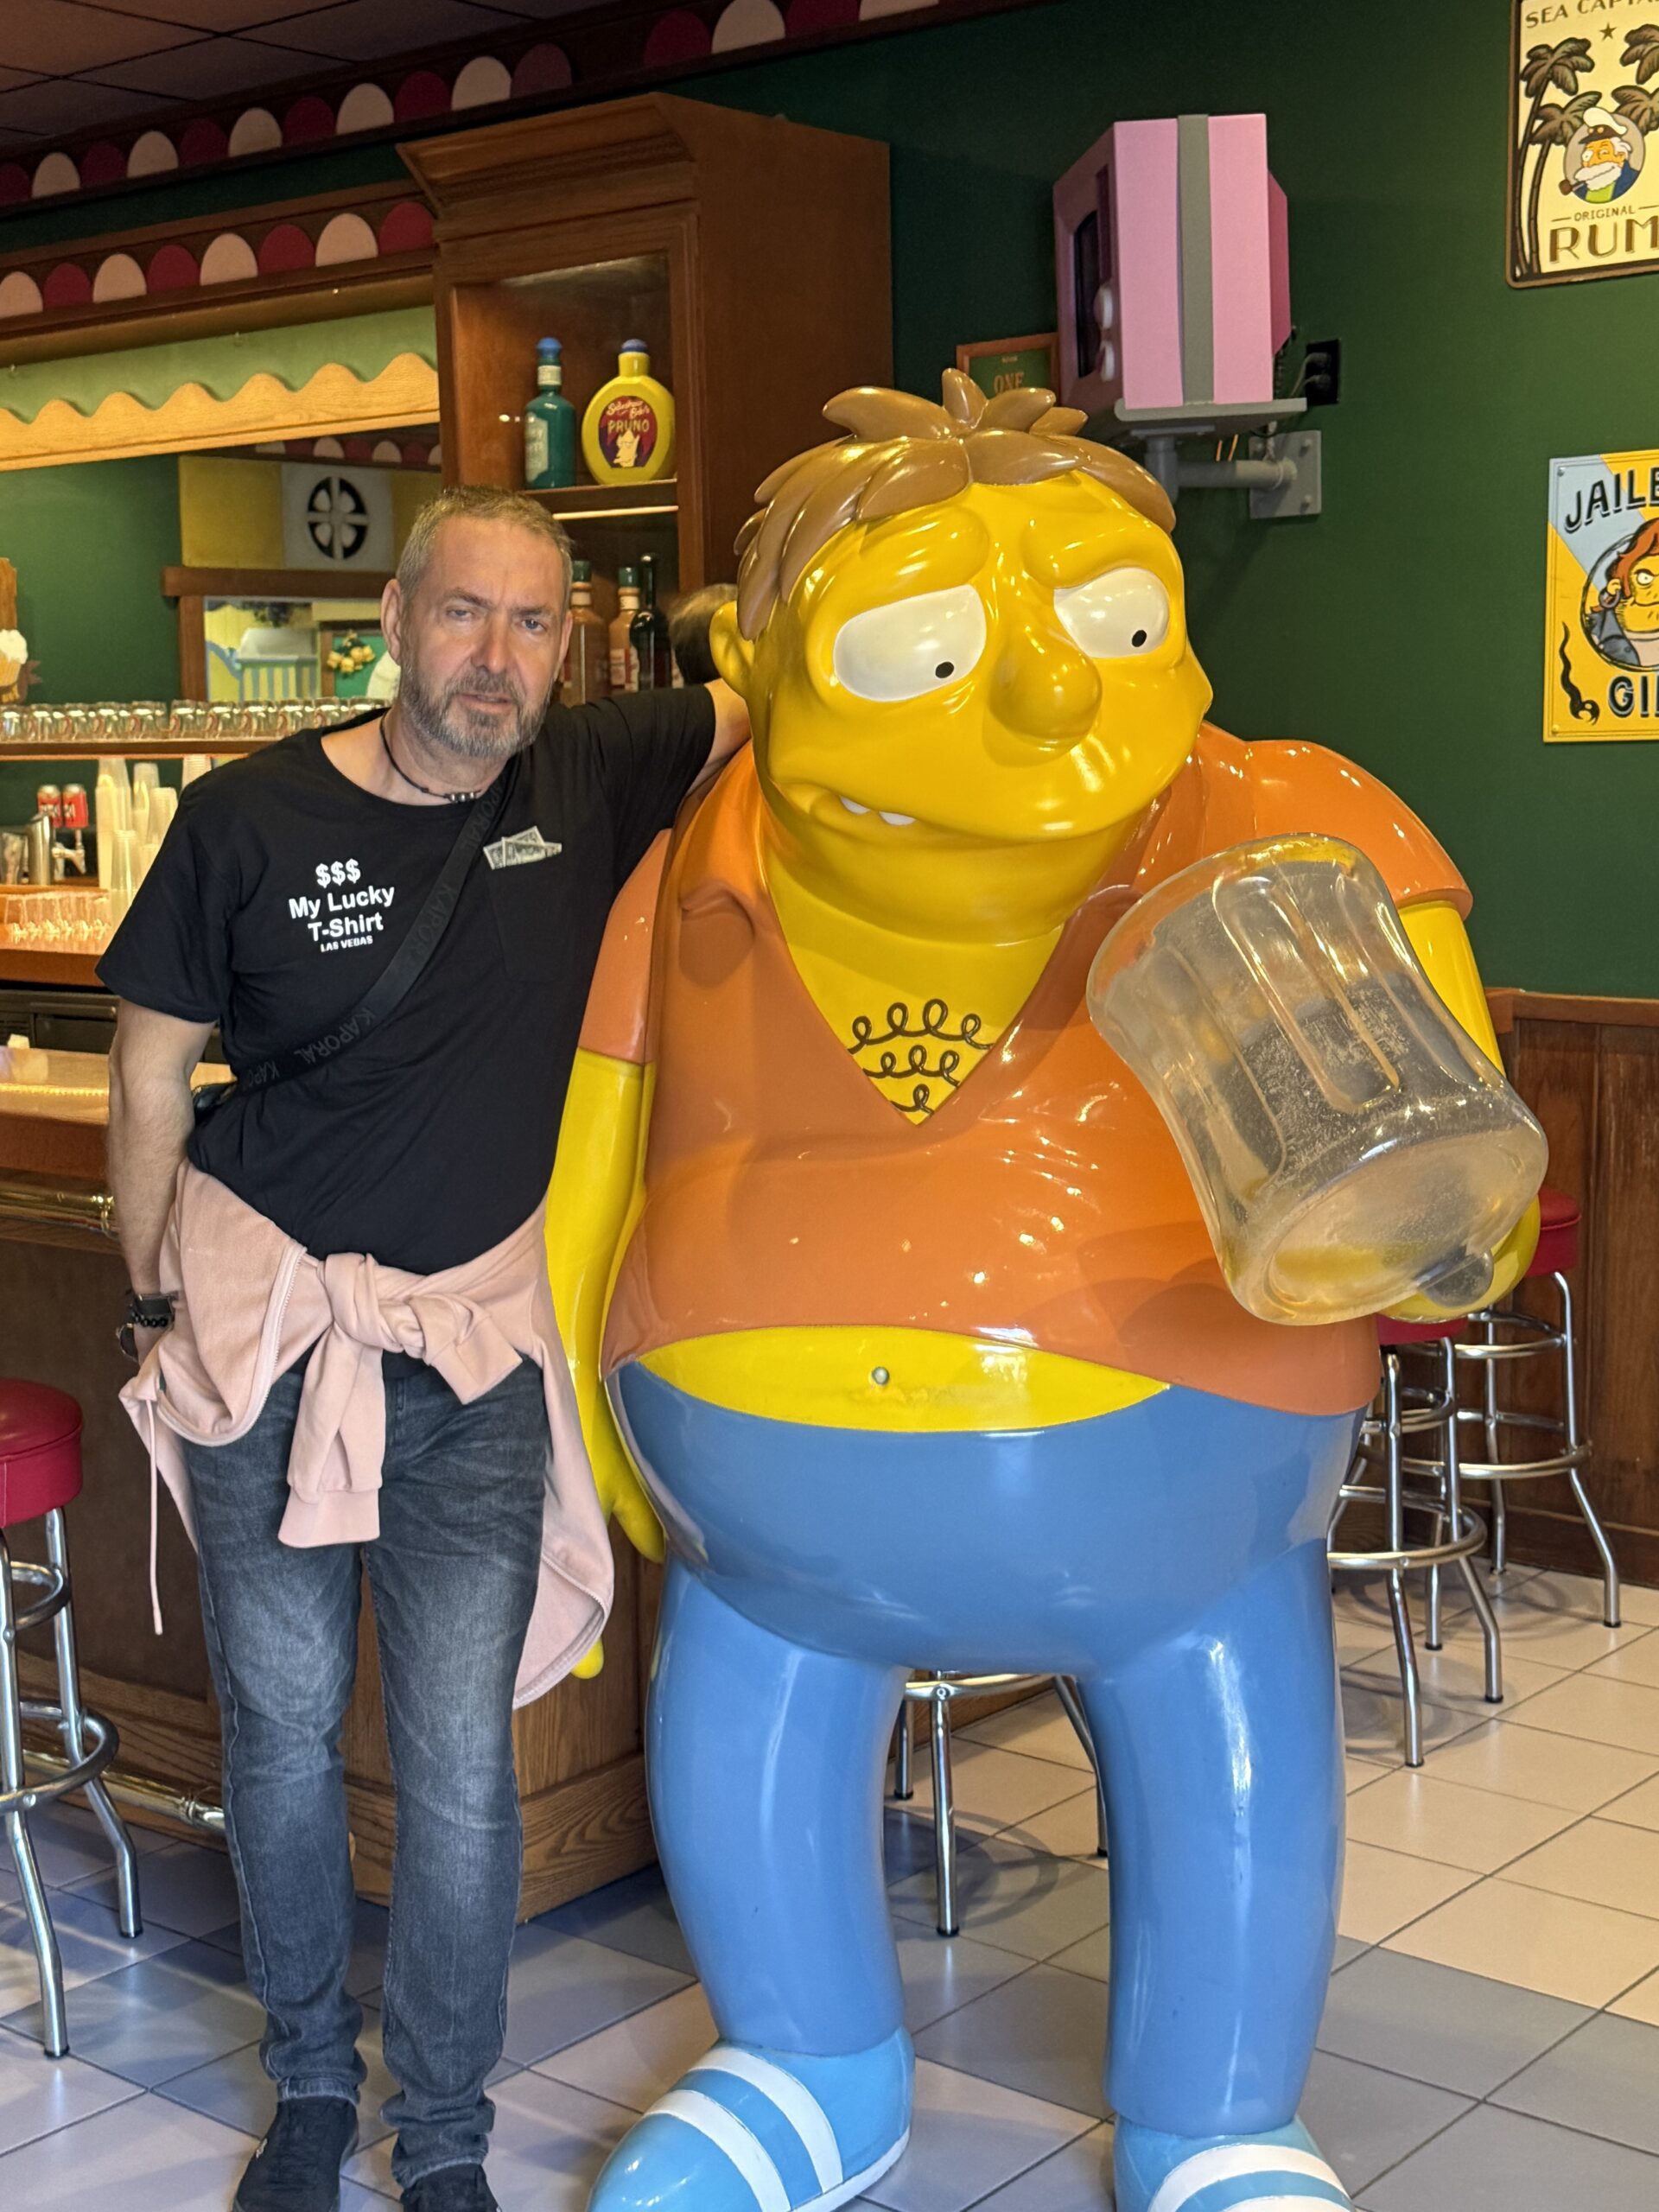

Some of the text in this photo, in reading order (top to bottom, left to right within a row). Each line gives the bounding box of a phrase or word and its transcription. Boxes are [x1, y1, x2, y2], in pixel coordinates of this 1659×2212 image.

[1526, 0, 1659, 29] SEA CAP
[1573, 205, 1636, 222] ORIGINAL
[1548, 215, 1659, 264] RUM
[607, 419, 650, 434] PRUNO
[315, 858, 361, 888] $$$
[289, 886, 395, 919] My Lucky
[308, 912, 385, 942] T-Shirt
[321, 935, 373, 953] LAS VEGAS
[293, 1007, 378, 1065] KAPORAL
